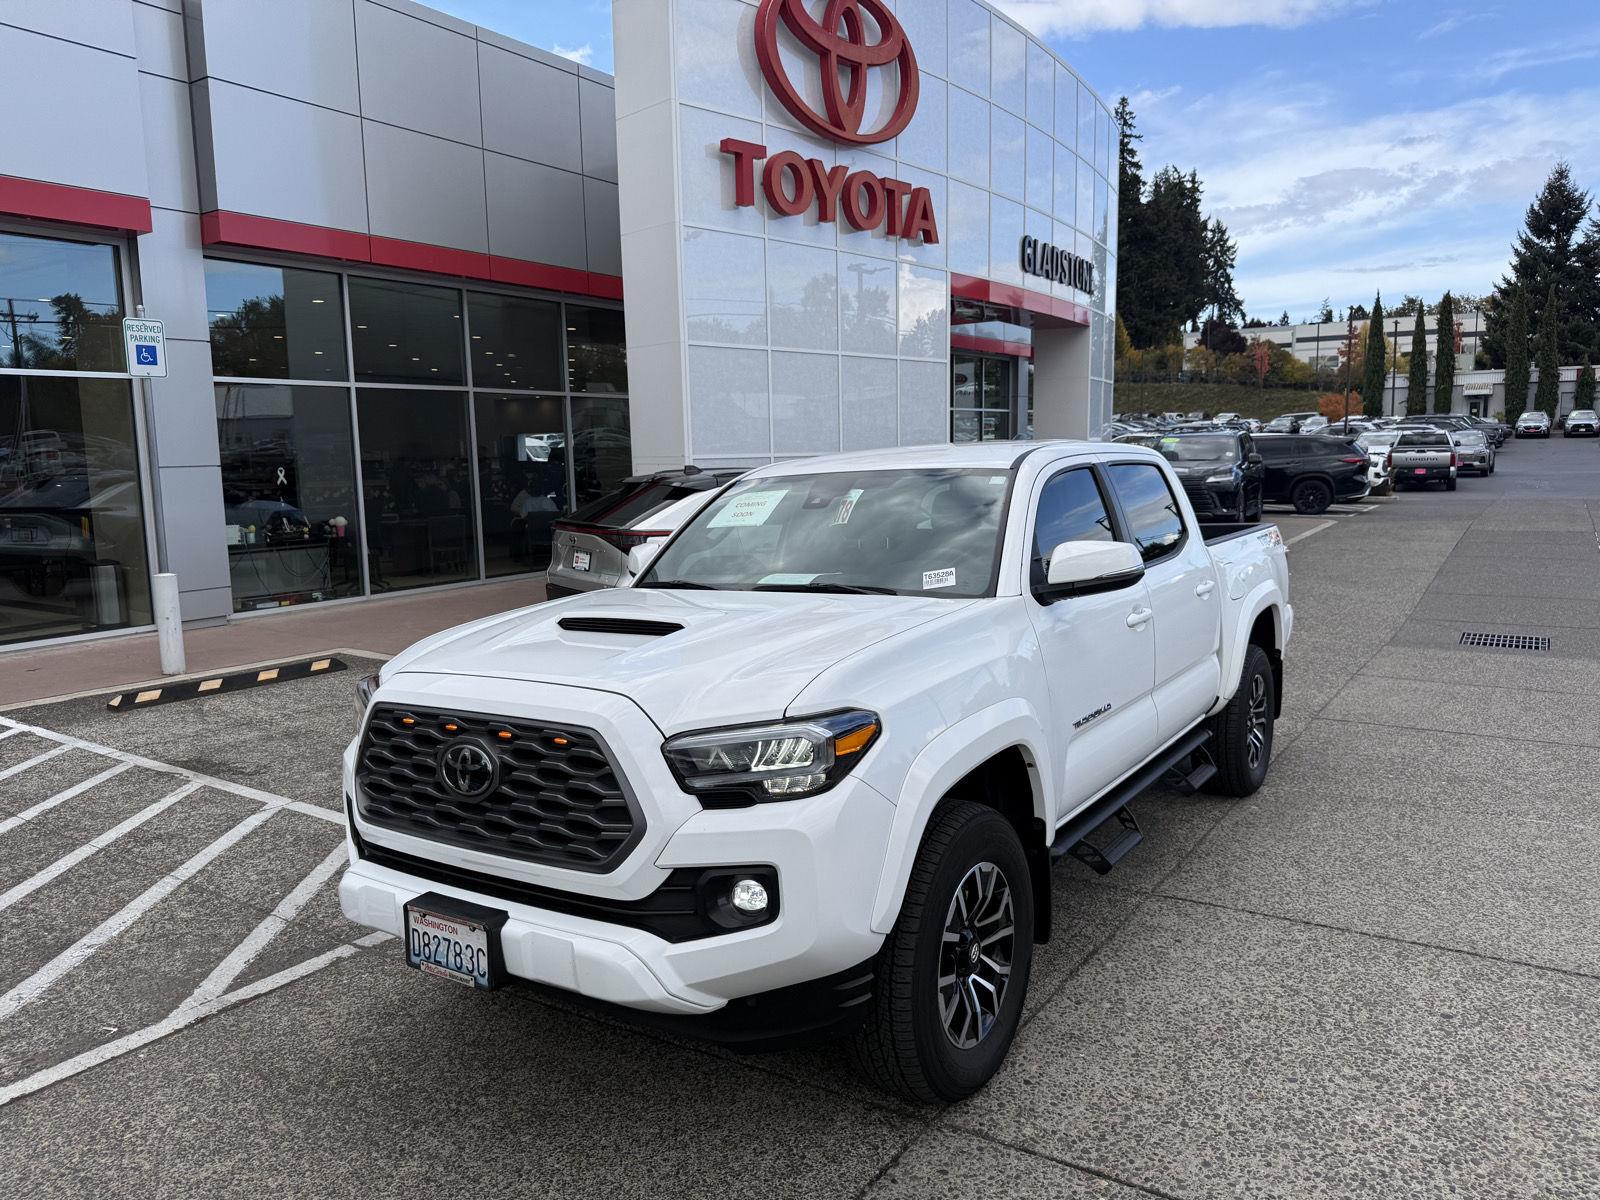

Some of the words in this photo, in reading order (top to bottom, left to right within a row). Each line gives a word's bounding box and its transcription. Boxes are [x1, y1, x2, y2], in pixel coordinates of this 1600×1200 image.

[720, 138, 939, 244] TOYOTA
[126, 323, 162, 334] RESERVED
[129, 334, 161, 344] PARKING
[735, 500, 768, 508] COMING
[923, 570, 954, 580] T63528A
[413, 916, 458, 935] WASHINGTON
[411, 927, 487, 978] D82783C
